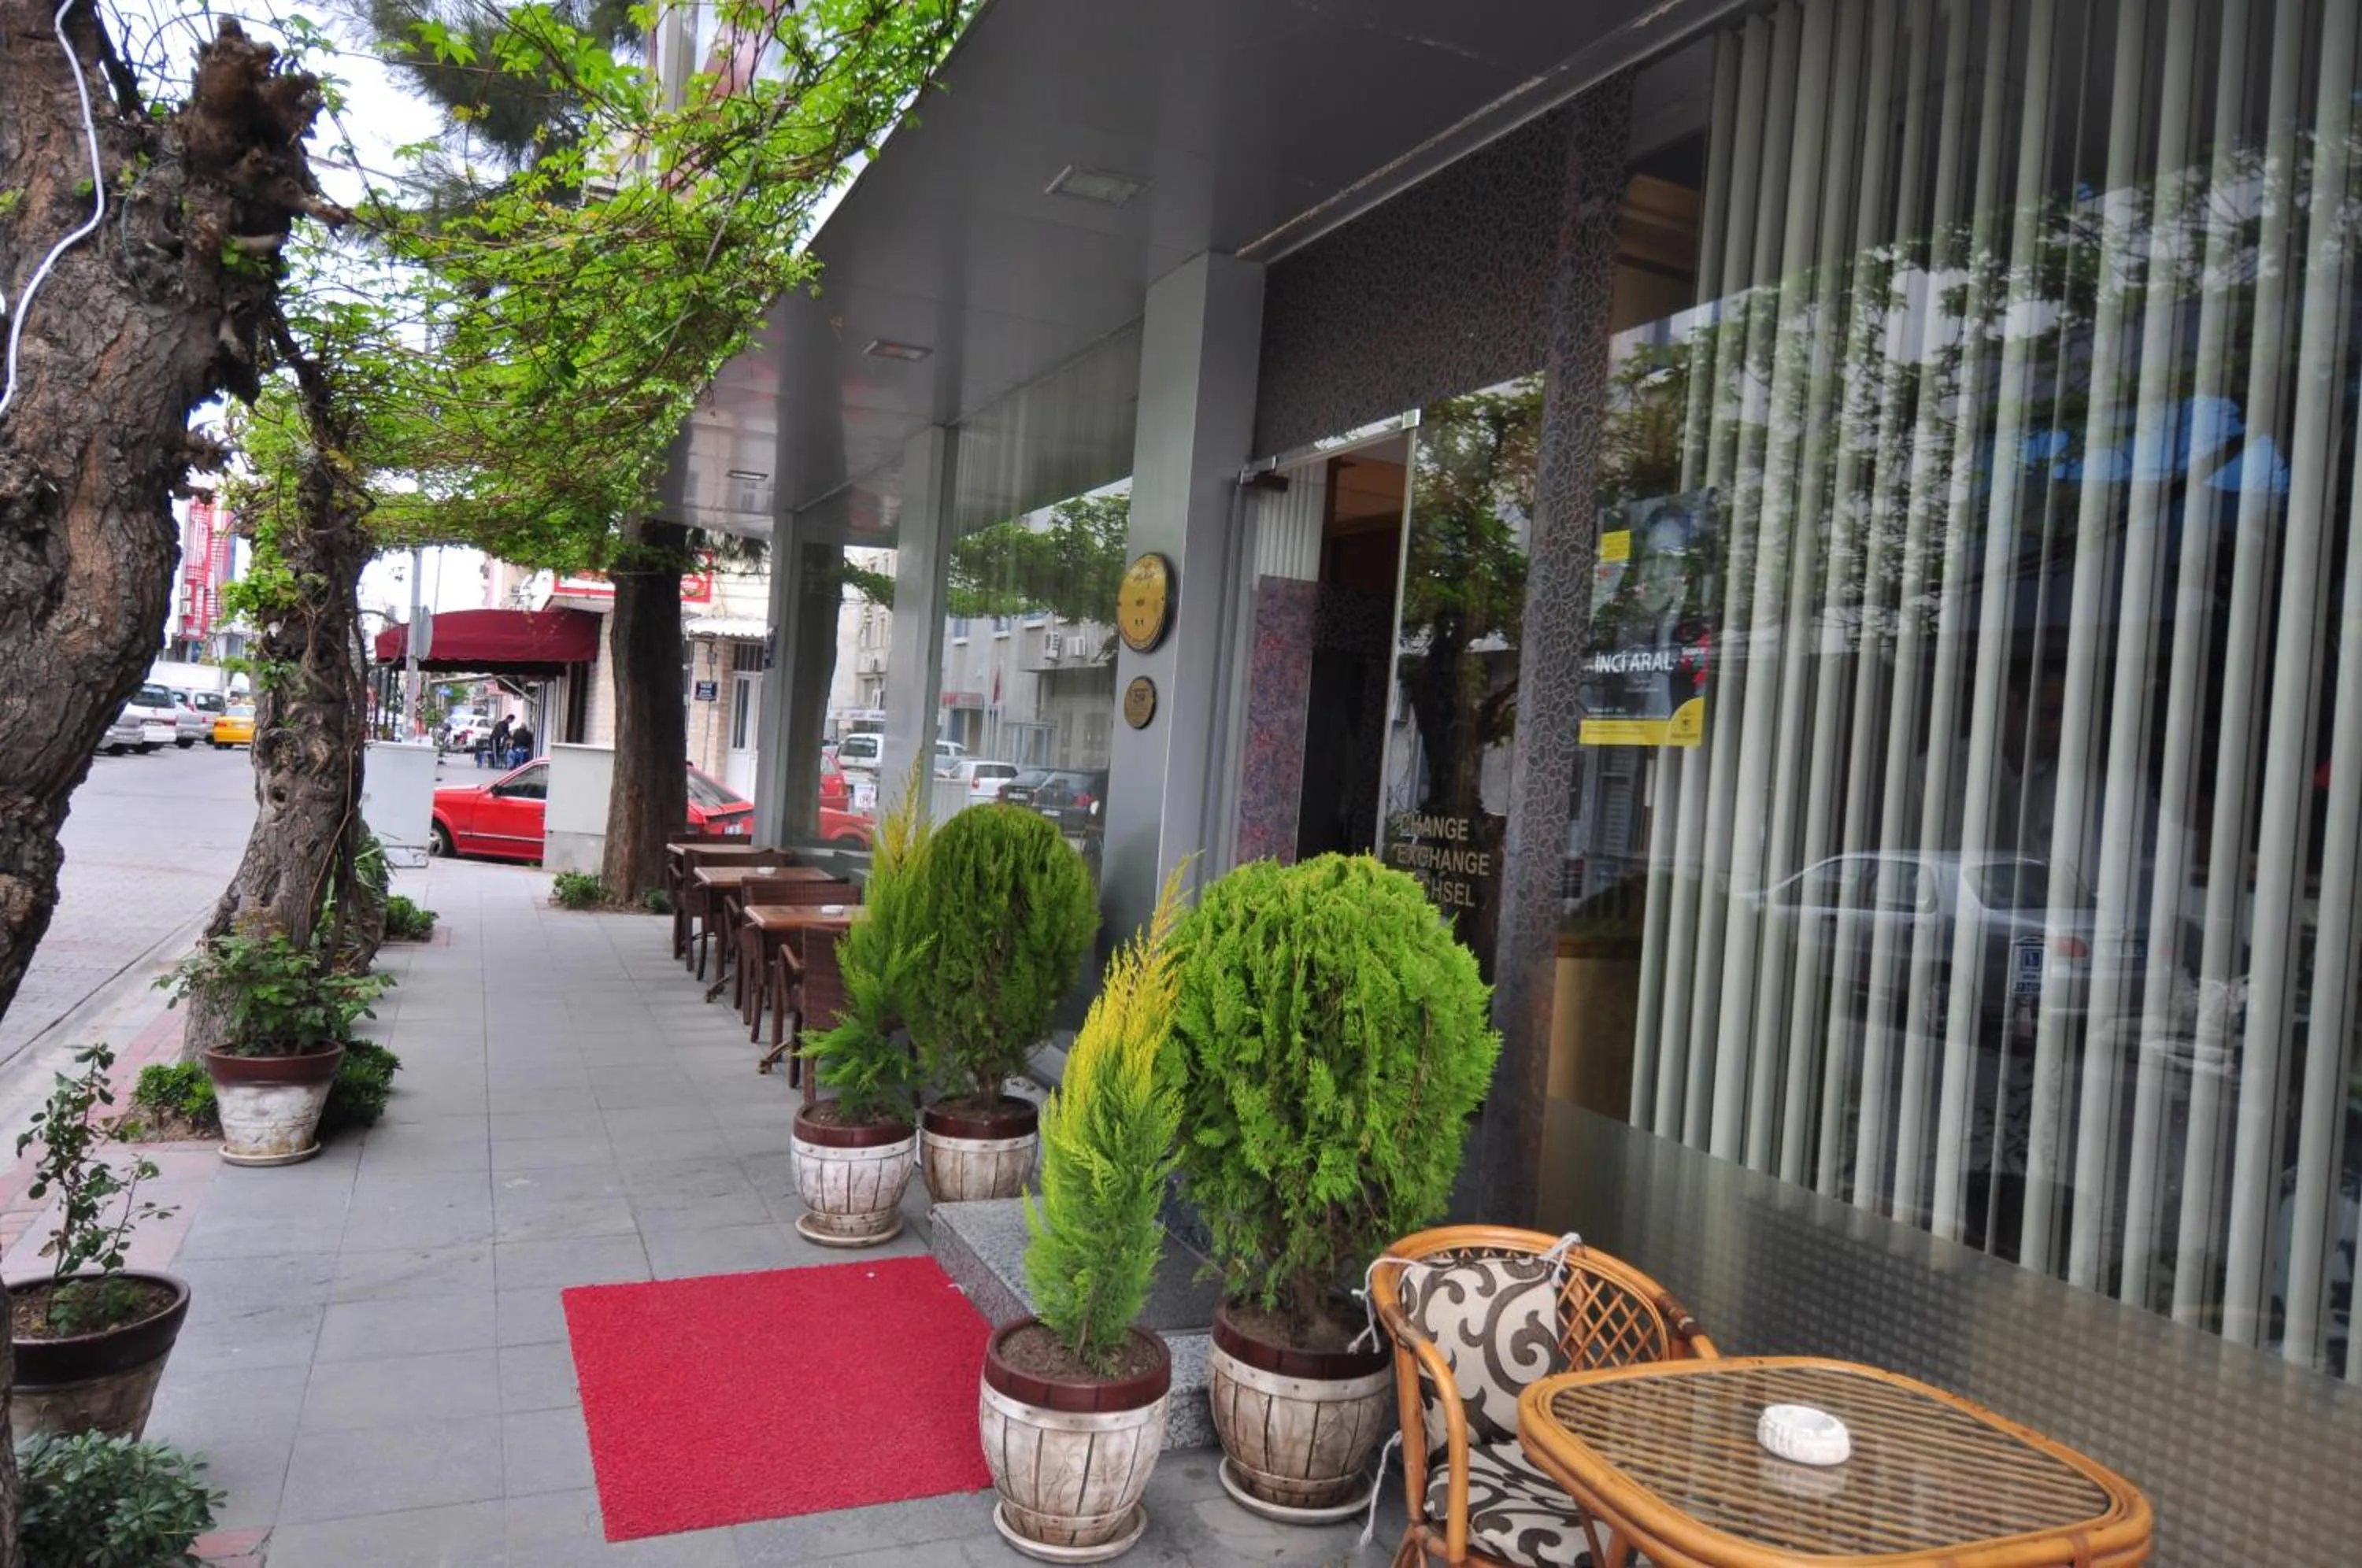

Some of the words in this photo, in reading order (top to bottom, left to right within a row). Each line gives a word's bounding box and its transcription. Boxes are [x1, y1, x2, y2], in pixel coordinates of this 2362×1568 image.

[1630, 651, 1674, 671] ARAL
[1399, 814, 1469, 841] CHANGE
[1396, 844, 1490, 876] EXCHANGE
